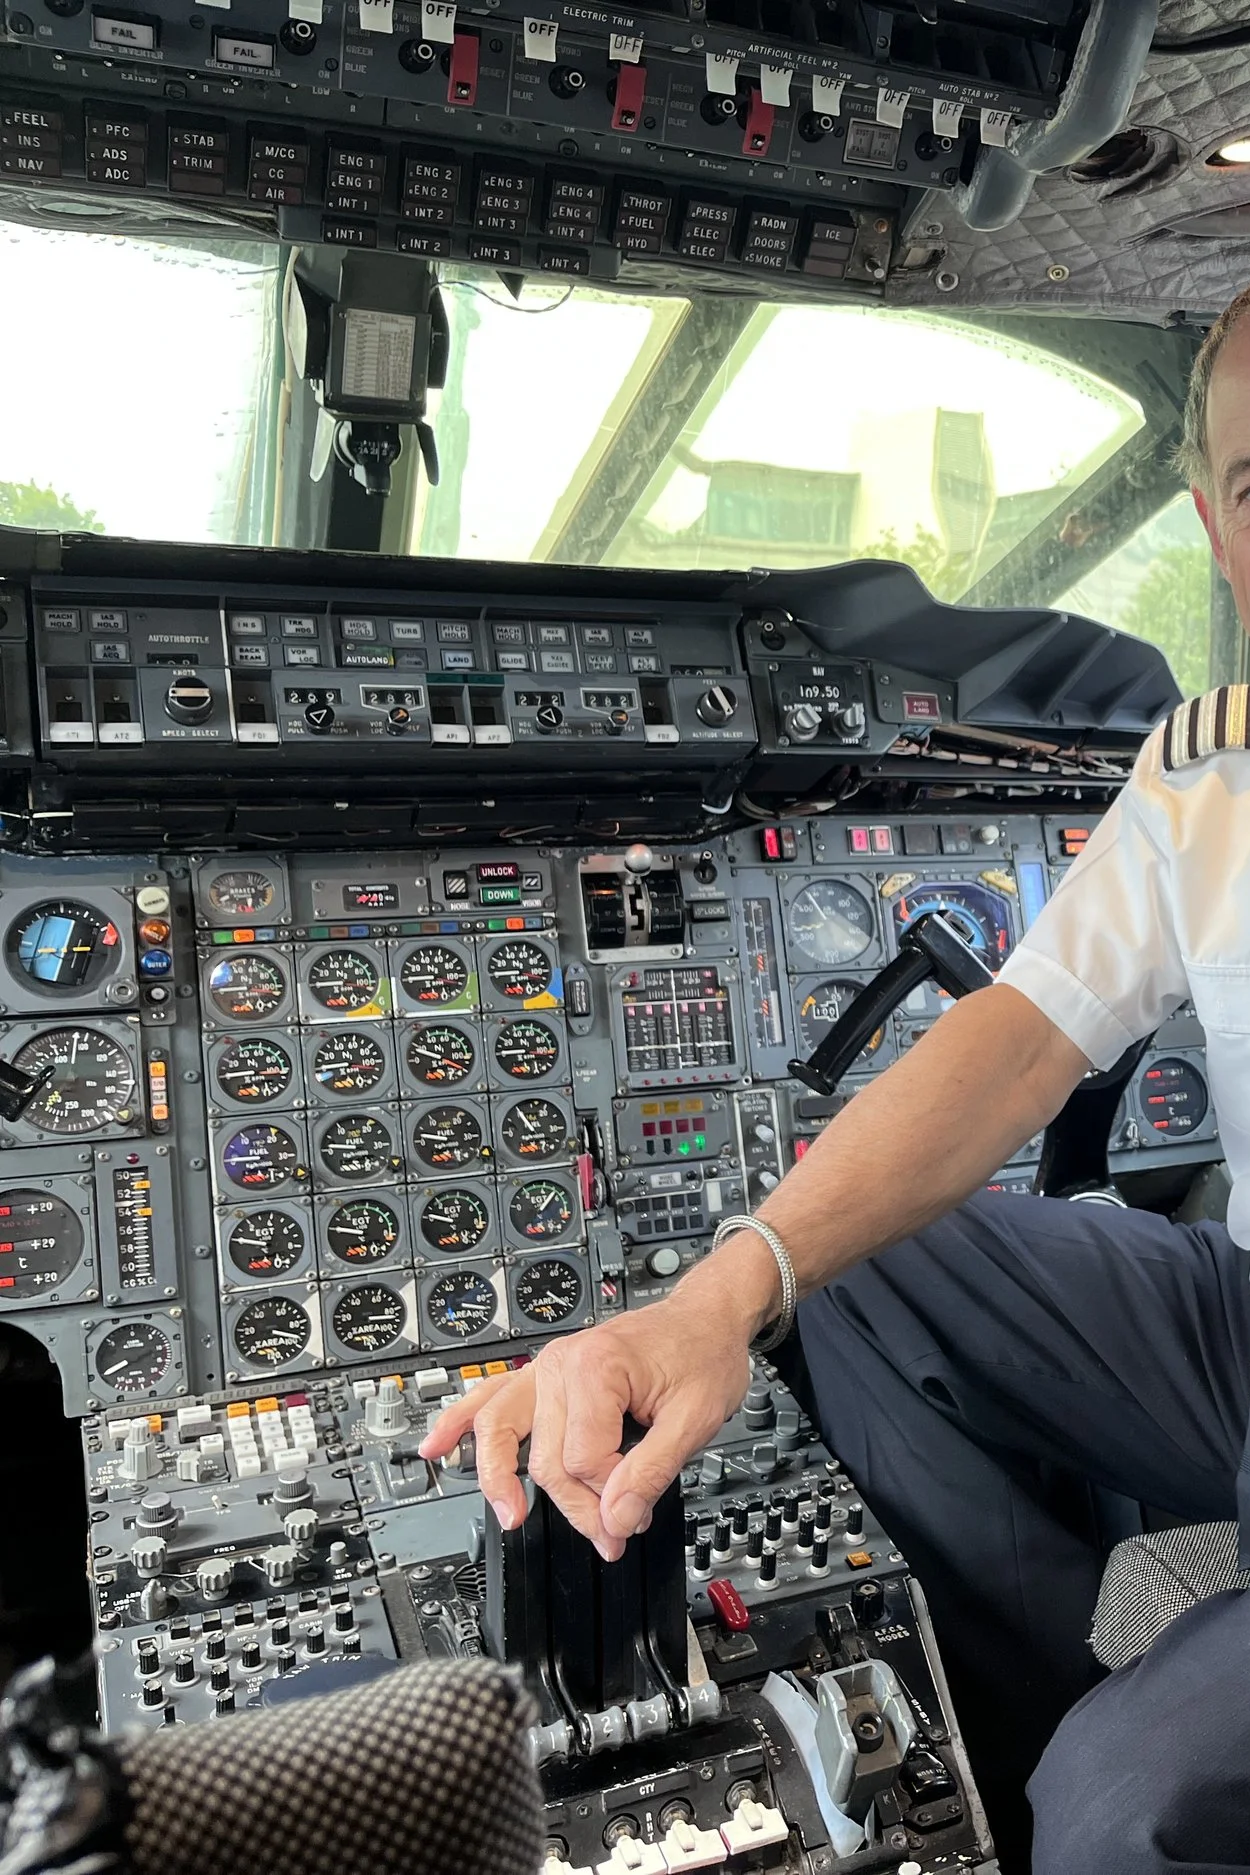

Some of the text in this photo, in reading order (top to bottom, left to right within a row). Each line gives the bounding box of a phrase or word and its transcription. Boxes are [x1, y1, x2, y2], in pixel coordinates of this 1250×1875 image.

[426, 3, 454, 18] OFF
[563, 6, 634, 28] ELECTRIC TRIM
[111, 27, 137, 40] FAIL
[529, 22, 556, 37] OFF
[614, 35, 642, 53] OFF
[233, 47, 257, 58] FAIL
[726, 48, 746, 59] PITCH
[748, 44, 818, 66] ARTIFICIAL FEEL
[715, 54, 736, 65] OFF
[783, 60, 799, 70] ROLL
[821, 77, 843, 91] OFF
[884, 89, 908, 106] OFF
[938, 83, 981, 99] AUTO STAB
[940, 102, 961, 117] OFF
[14, 111, 48, 127] FEEL
[987, 112, 1008, 127] OFF
[106, 124, 130, 137] PFC
[18, 134, 41, 148] INS
[183, 134, 215, 147] STAB
[103, 148, 128, 161] ADS
[265, 146, 295, 159] M/CG
[18, 158, 44, 171] NAV
[183, 156, 213, 169] TRIM
[339, 154, 374, 169] ENG 1
[105, 168, 130, 181] ADC
[268, 168, 285, 180] CG
[416, 165, 452, 180] ENG 2
[338, 174, 372, 189] ENG 1
[490, 176, 523, 190] ENG 3
[265, 187, 285, 200] AIR
[414, 184, 448, 199] ENG 2
[561, 185, 593, 199] ENG 4
[338, 197, 368, 211] INT 1
[487, 196, 520, 210] ENG 3
[629, 196, 663, 212] THROT
[414, 207, 444, 220] INT 2
[559, 206, 592, 220] ENG 4
[696, 206, 728, 221] PRESS
[487, 217, 516, 230] INT 3
[628, 217, 654, 230] FUEL
[761, 217, 787, 230] RADN
[335, 228, 363, 241] INT 1
[557, 226, 585, 239] INT 4
[693, 227, 720, 240] ELEC
[826, 229, 841, 240] ICE
[410, 239, 441, 252] INT 2
[627, 236, 648, 249] HYD
[754, 236, 786, 251] DOORS
[480, 247, 510, 261] INT 3
[690, 245, 716, 257] ELEC
[551, 258, 580, 271] INT 4
[749, 253, 783, 267] SMOKE
[97, 621, 120, 629] HOLD
[148, 634, 210, 644] AUTOTHROTTLE
[346, 655, 389, 665] AUTOLAND
[481, 866, 514, 877] UNLOCK
[487, 891, 514, 900] DOWN
[116, 1171, 130, 1180] 50
[117, 1190, 131, 1199] 52
[118, 1208, 132, 1216] 54
[352, 1216, 370, 1225] EGT
[119, 1226, 133, 1235] 56
[255, 1228, 275, 1236] EGT
[120, 1244, 134, 1253] 58
[122, 1263, 135, 1272] 60
[699, 1688, 710, 1702] 4
[648, 1704, 659, 1724] 3
[600, 1716, 614, 1734] 2
[639, 1783, 655, 1796] CTY
